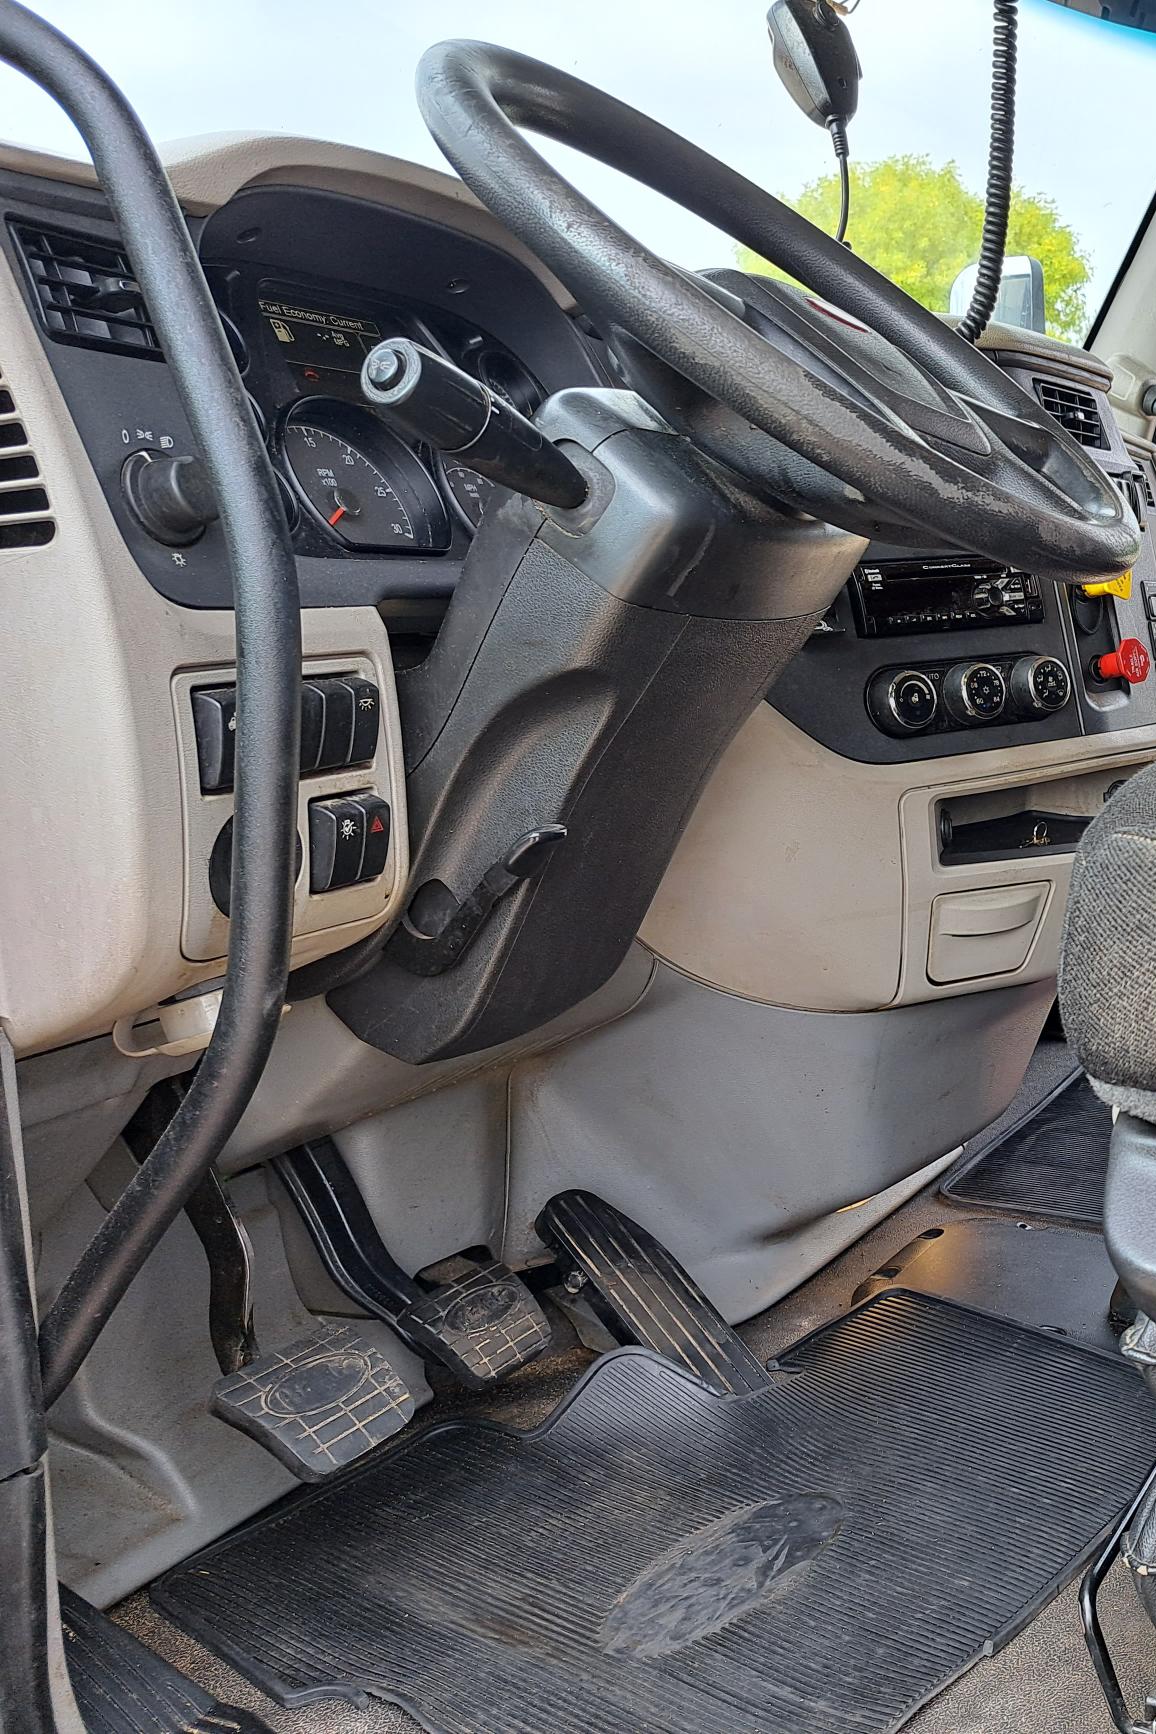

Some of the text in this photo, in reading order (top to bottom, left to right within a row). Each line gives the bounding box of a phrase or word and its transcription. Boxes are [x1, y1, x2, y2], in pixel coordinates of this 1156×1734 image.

[259, 302, 281, 313] Fuel
[330, 316, 364, 330] Current
[304, 437, 316, 448] 15
[342, 454, 355, 465] 20
[317, 468, 335, 477] RPM
[374, 486, 387, 497] 25
[391, 523, 403, 534] 30
